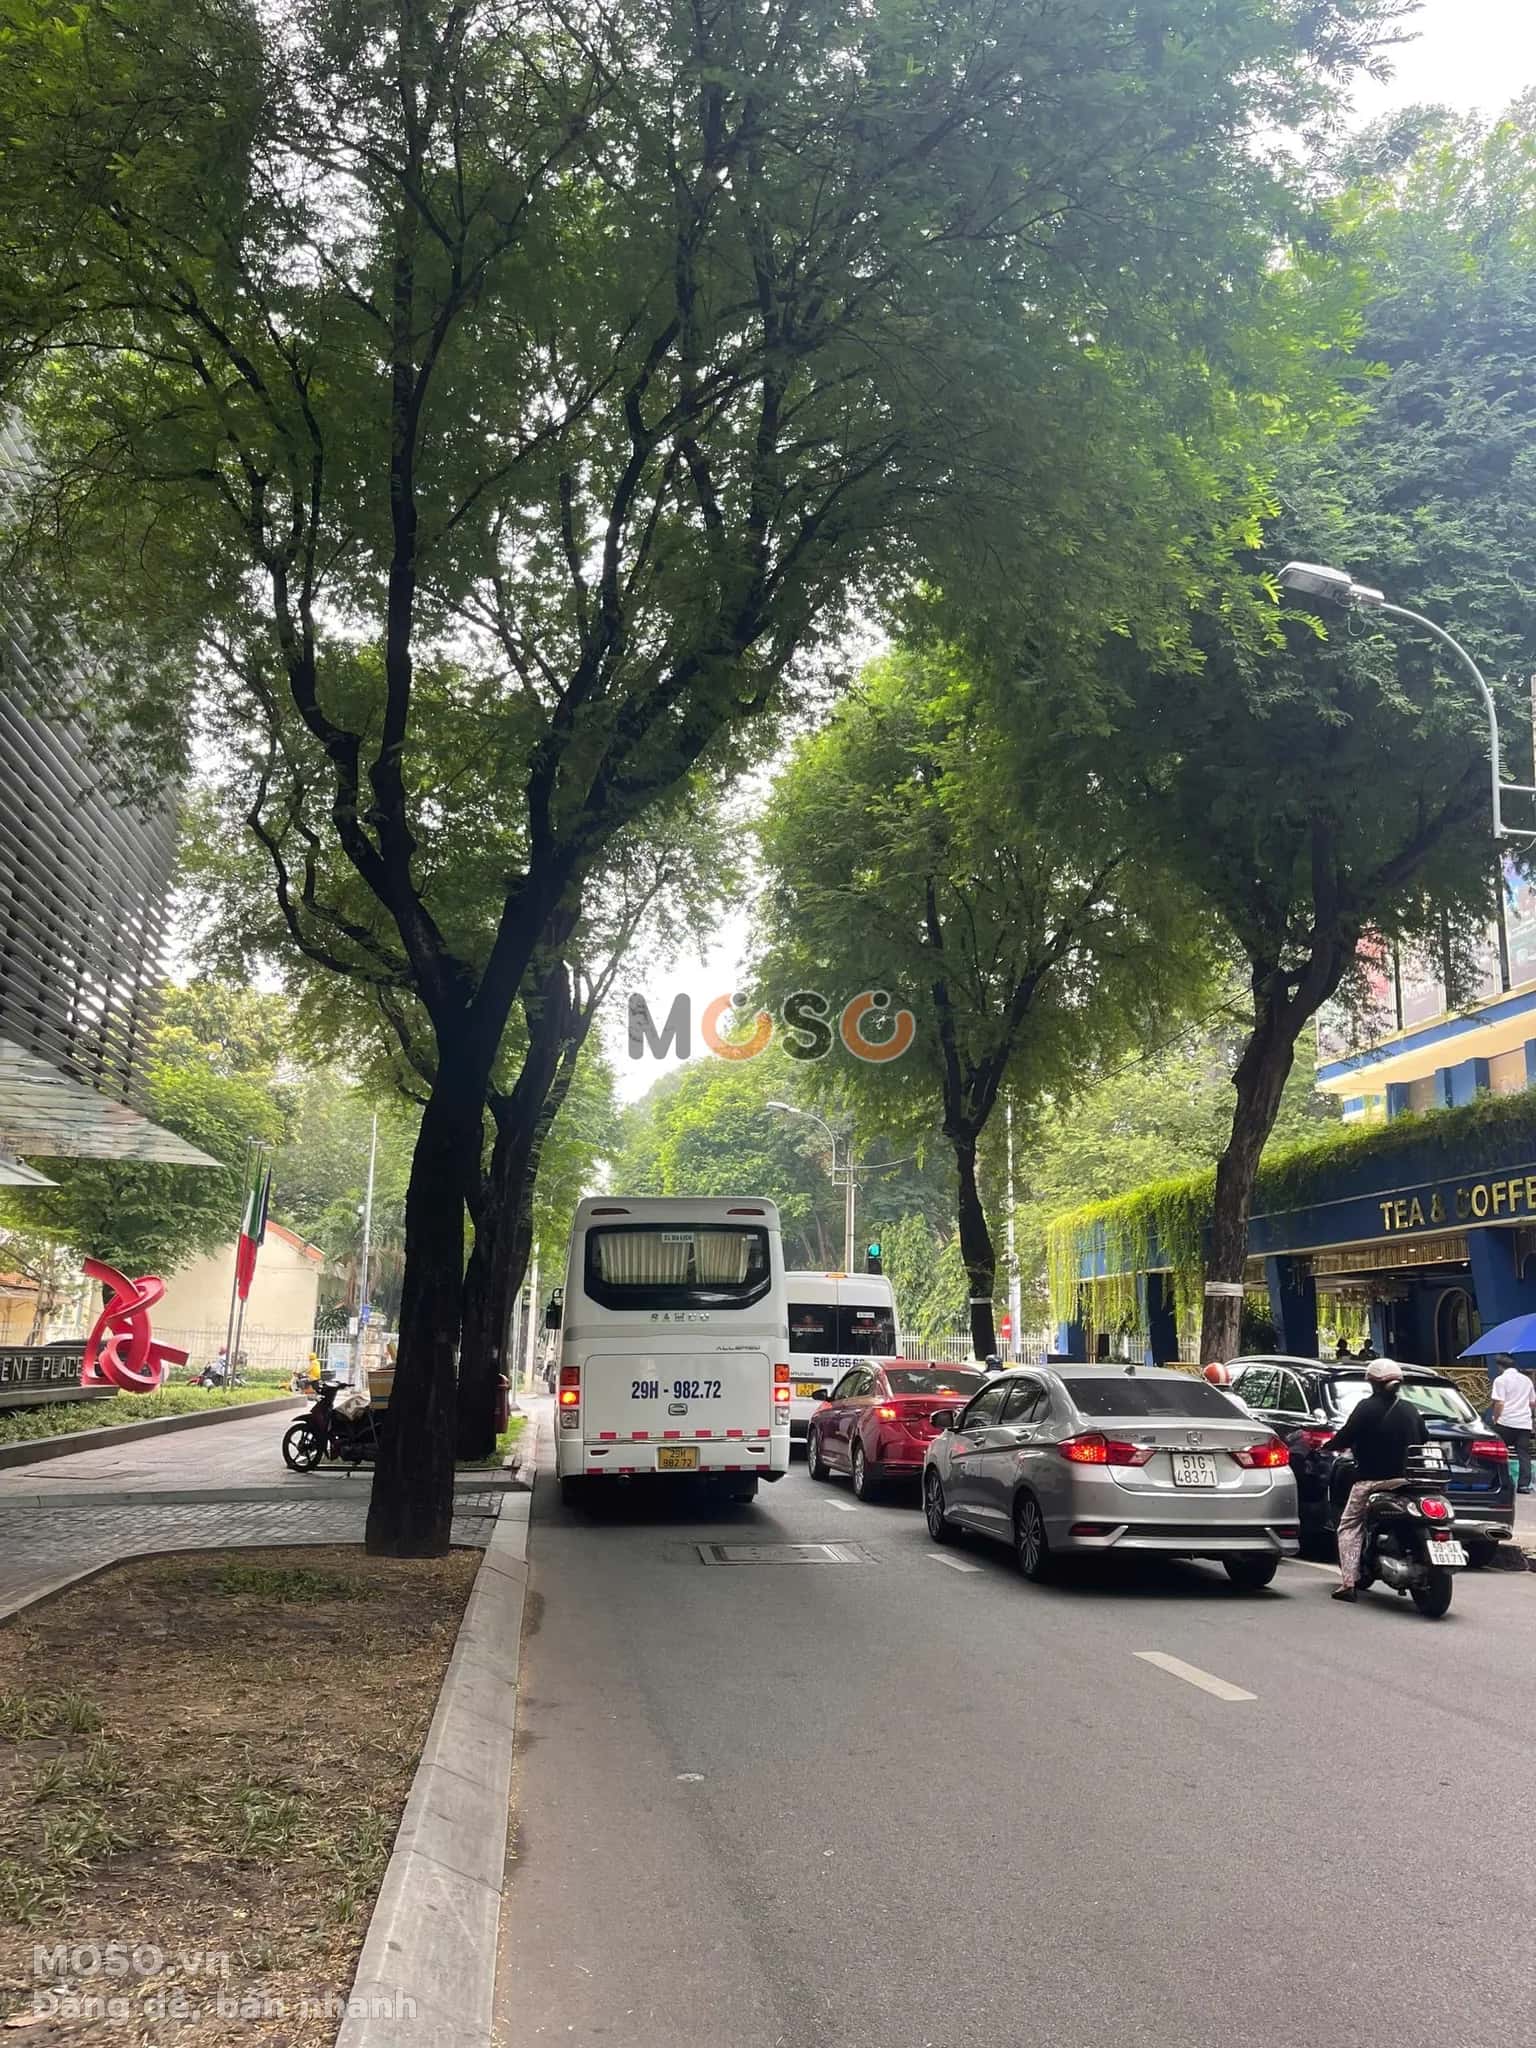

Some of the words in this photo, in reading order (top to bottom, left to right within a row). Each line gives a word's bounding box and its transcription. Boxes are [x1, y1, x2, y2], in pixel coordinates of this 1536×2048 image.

[1380, 1197, 1425, 1231] TEA
[1430, 1193, 1446, 1223] &
[631, 1380, 659, 1399] 29H
[673, 1380, 722, 1399] 982.72
[1182, 1455, 1206, 1469] 51G
